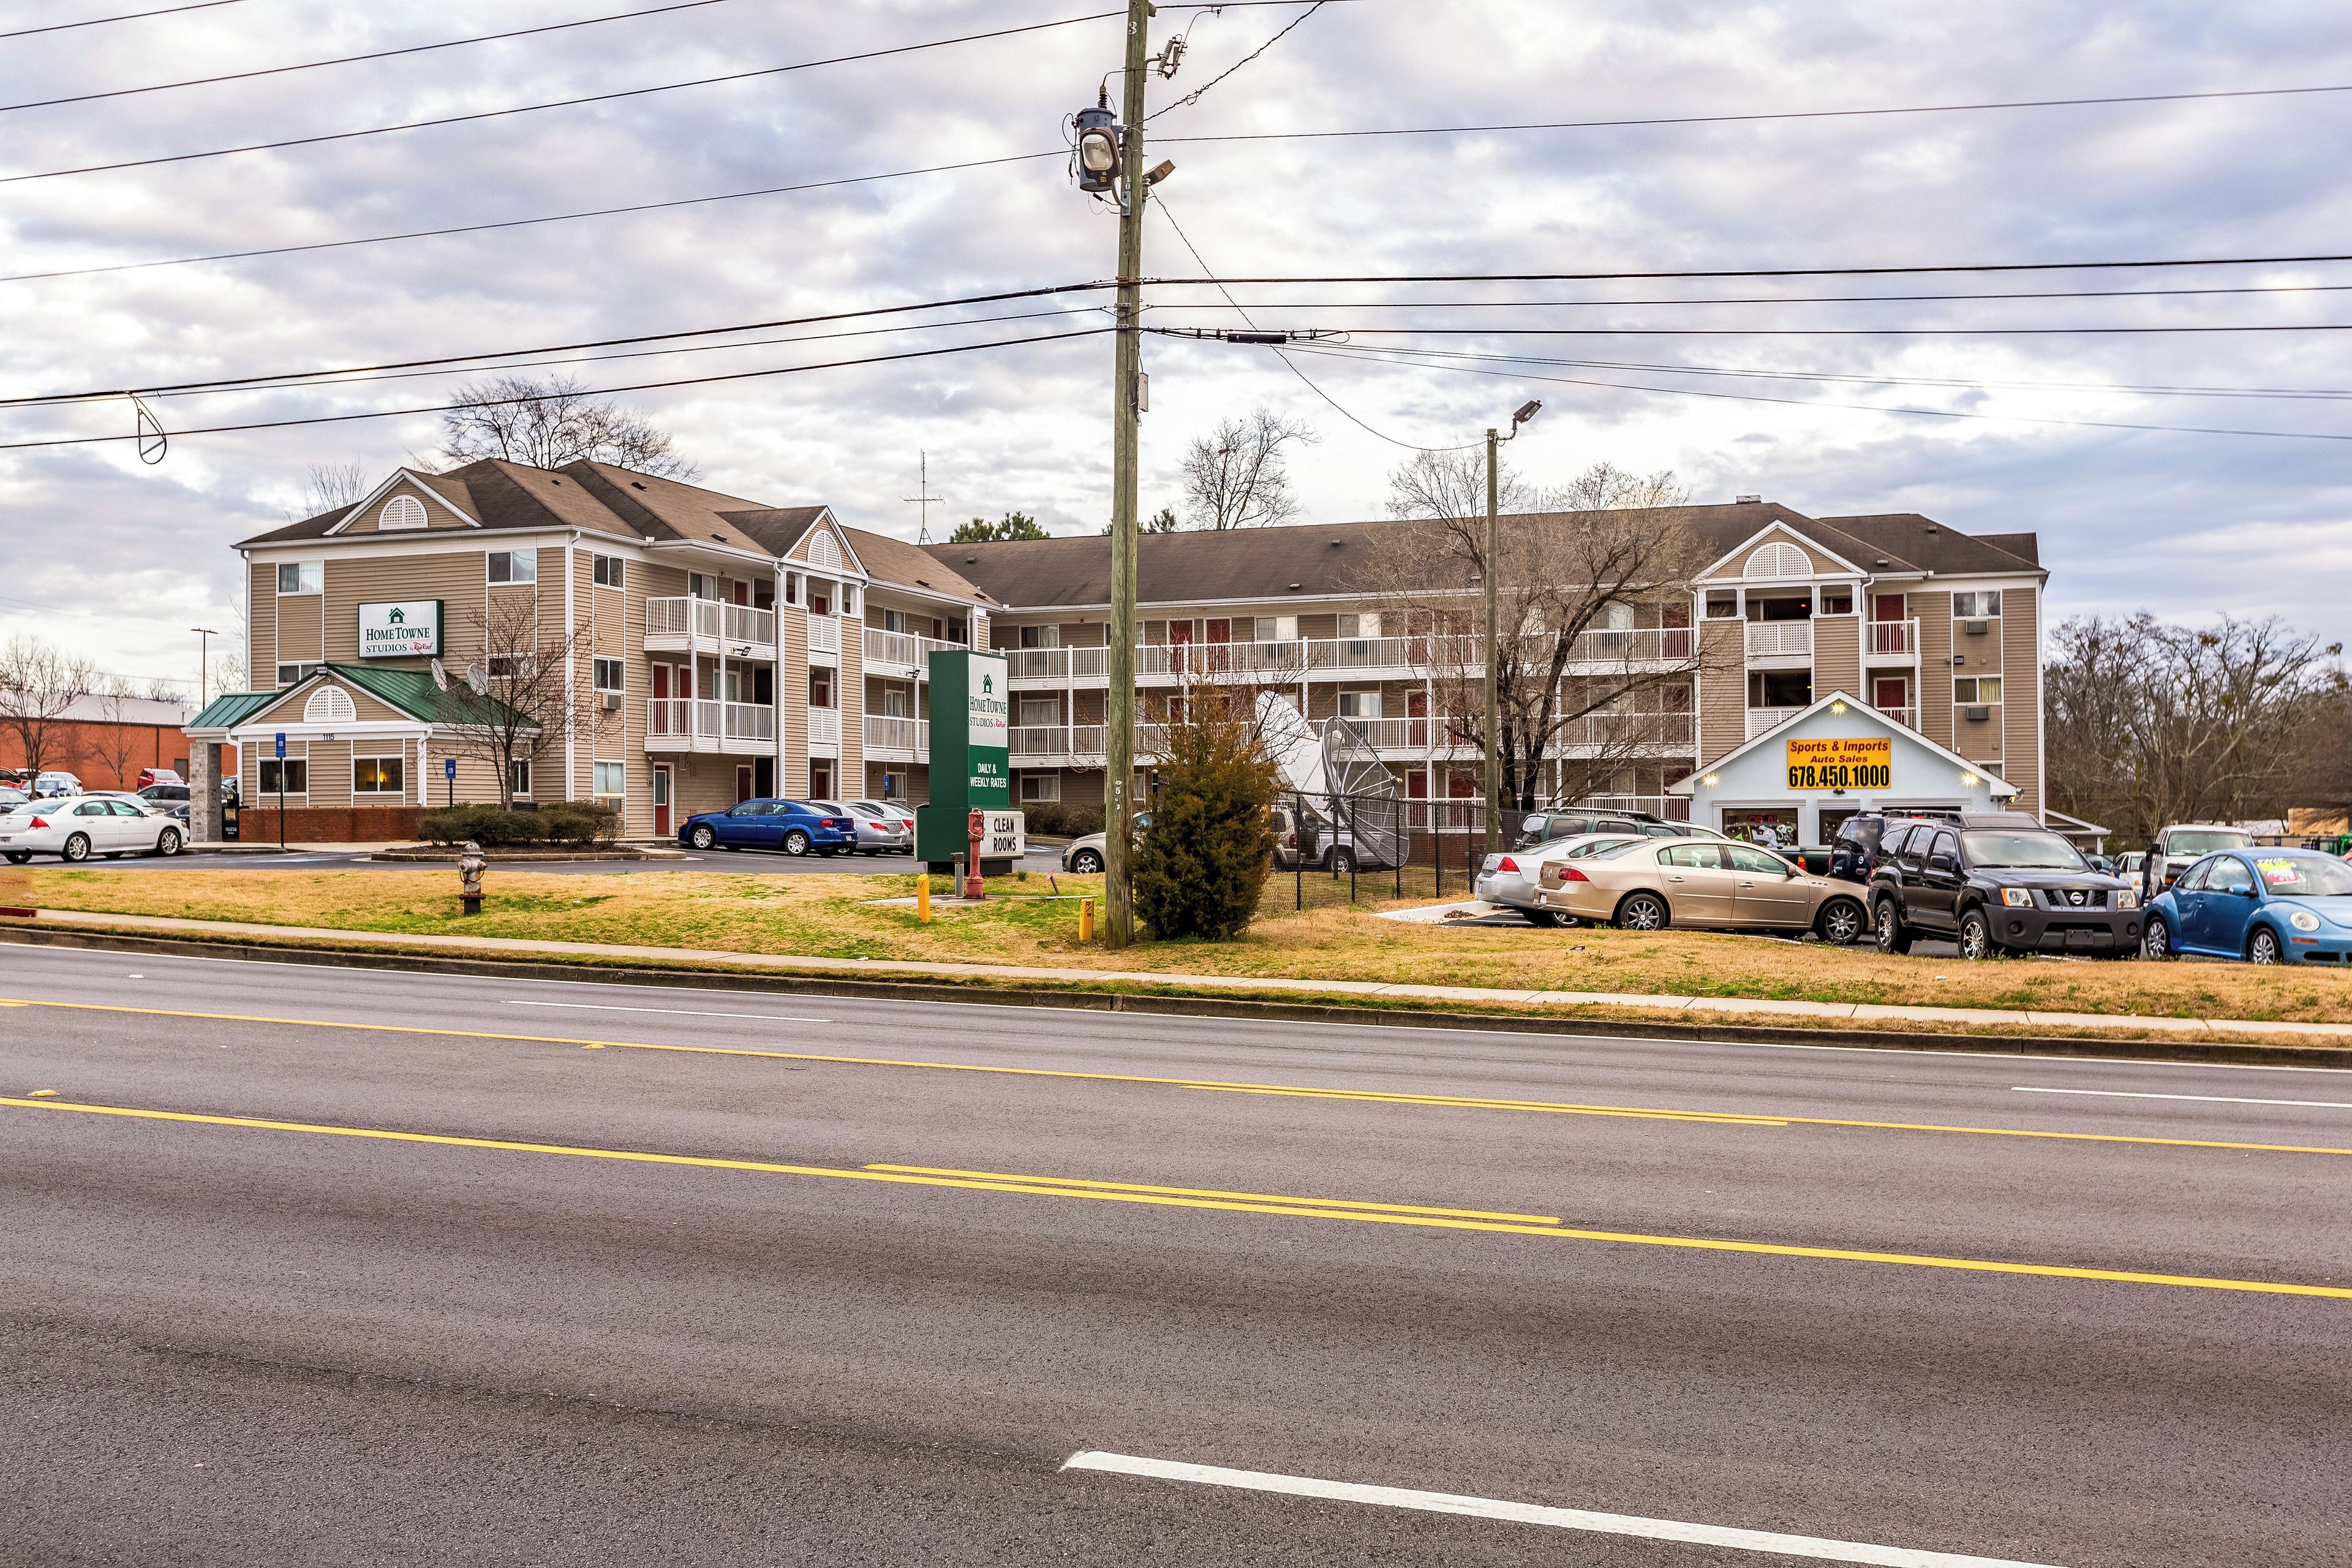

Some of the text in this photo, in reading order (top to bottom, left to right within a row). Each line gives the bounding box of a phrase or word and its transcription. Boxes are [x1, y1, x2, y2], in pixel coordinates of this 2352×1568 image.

[1128, 20, 1137, 35] 3
[366, 644, 407, 653] STUDIOS
[970, 717, 993, 728] STUDIOS
[1790, 741, 1888, 754] Sports & Imports
[978, 763, 997, 774] DAILY &
[970, 776, 1006, 788] WEEKLY RATES
[1789, 764, 1890, 788] 678.450.1000
[993, 818, 1014, 833] CLEAN
[993, 837, 1016, 852] ROOMS
